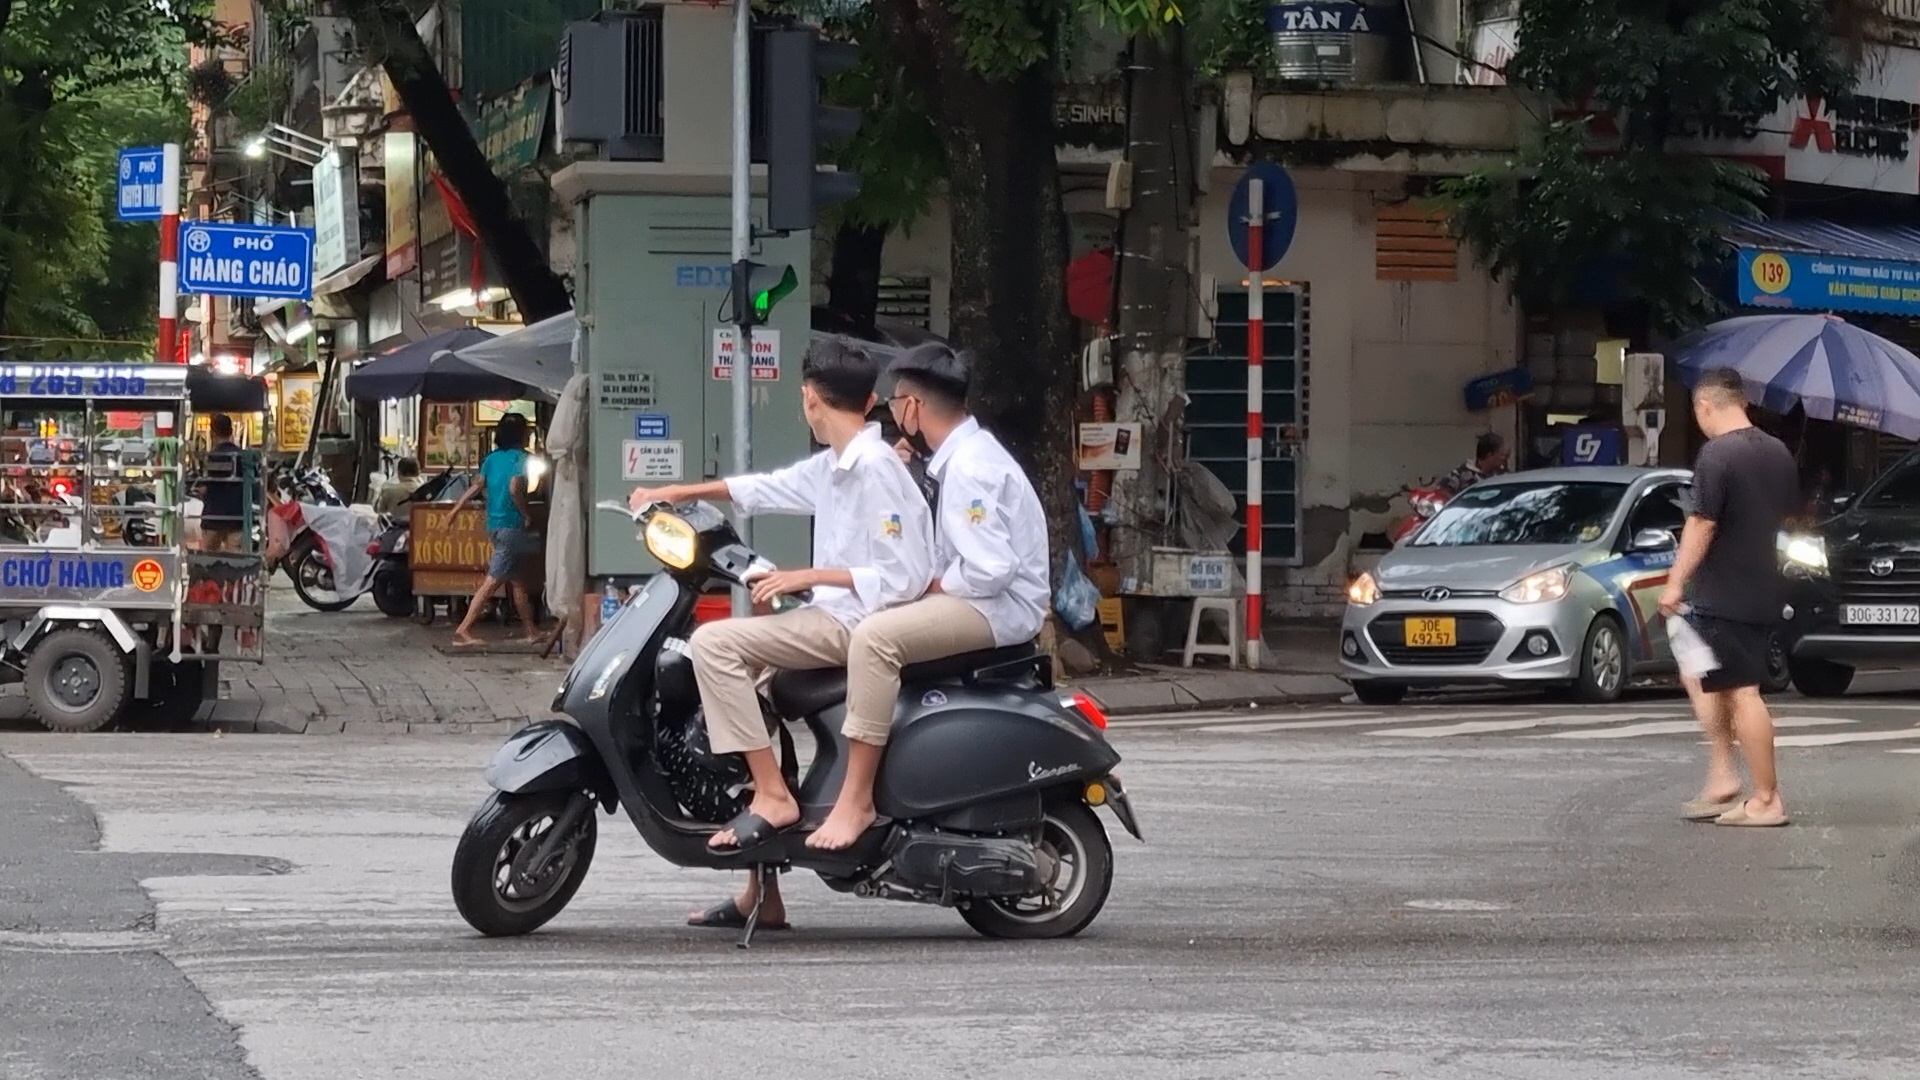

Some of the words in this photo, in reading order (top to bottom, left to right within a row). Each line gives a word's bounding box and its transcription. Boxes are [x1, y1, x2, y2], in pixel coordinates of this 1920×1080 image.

[1283, 5, 1342, 30] TÂN
[1350, 7, 1370, 31] Á
[1071, 104, 1112, 123] SINH
[233, 233, 276, 251] PHỐ
[189, 252, 244, 284] HÀNG
[248, 257, 301, 287] CHÁO
[1761, 262, 1784, 284] 139
[1575, 433, 1602, 462] G7
[58, 555, 125, 588] HÀNG
[1420, 619, 1441, 632] 30E
